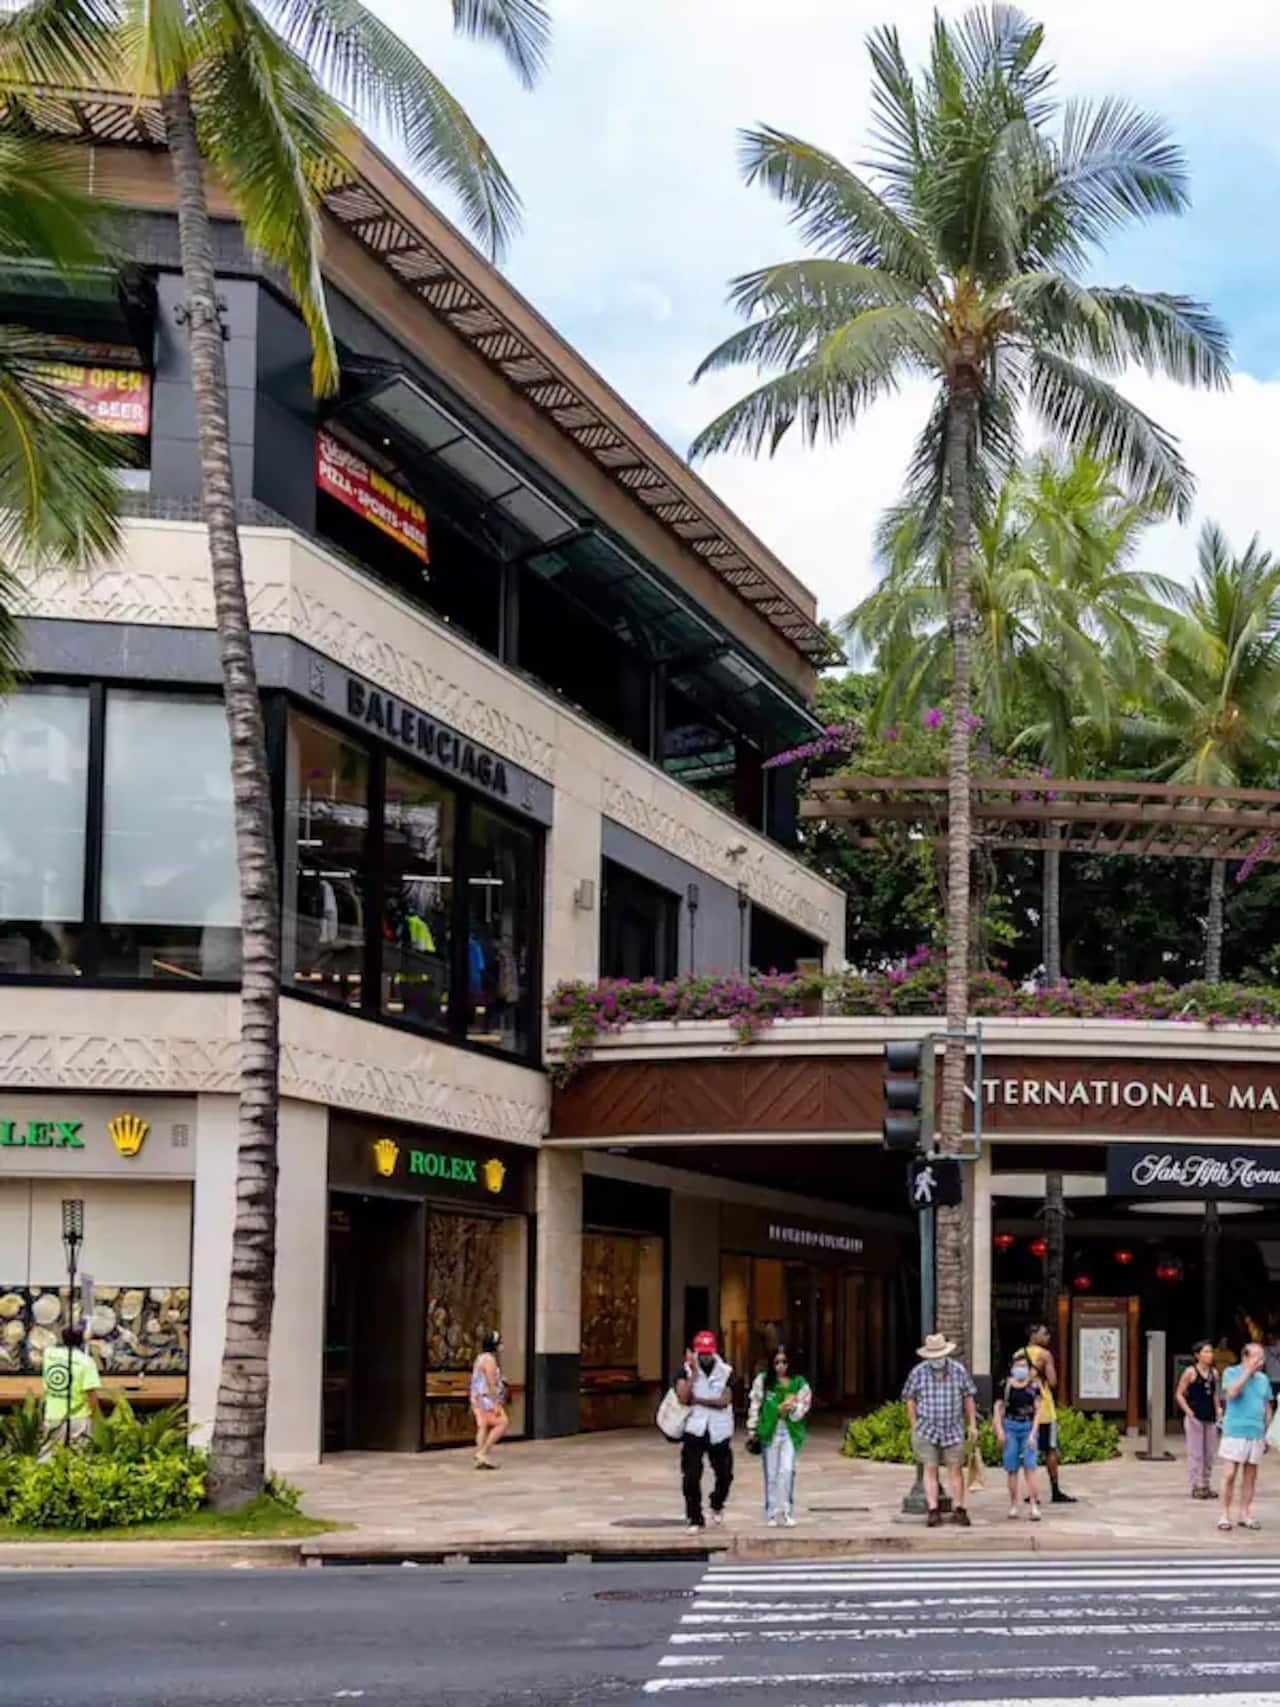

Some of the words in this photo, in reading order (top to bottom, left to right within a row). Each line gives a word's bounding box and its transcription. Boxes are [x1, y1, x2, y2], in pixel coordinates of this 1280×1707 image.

[90, 367, 144, 391] OPEN
[318, 459, 353, 496] PIZZA
[346, 678, 509, 795] BALENCIAGA
[963, 1078, 1215, 1109] TERNATIONAL
[0, 1120, 85, 1149] LEX
[408, 1149, 477, 1183] ROLEX
[1131, 1154, 1188, 1186] Saks
[1179, 1154, 1231, 1188] Fifth
